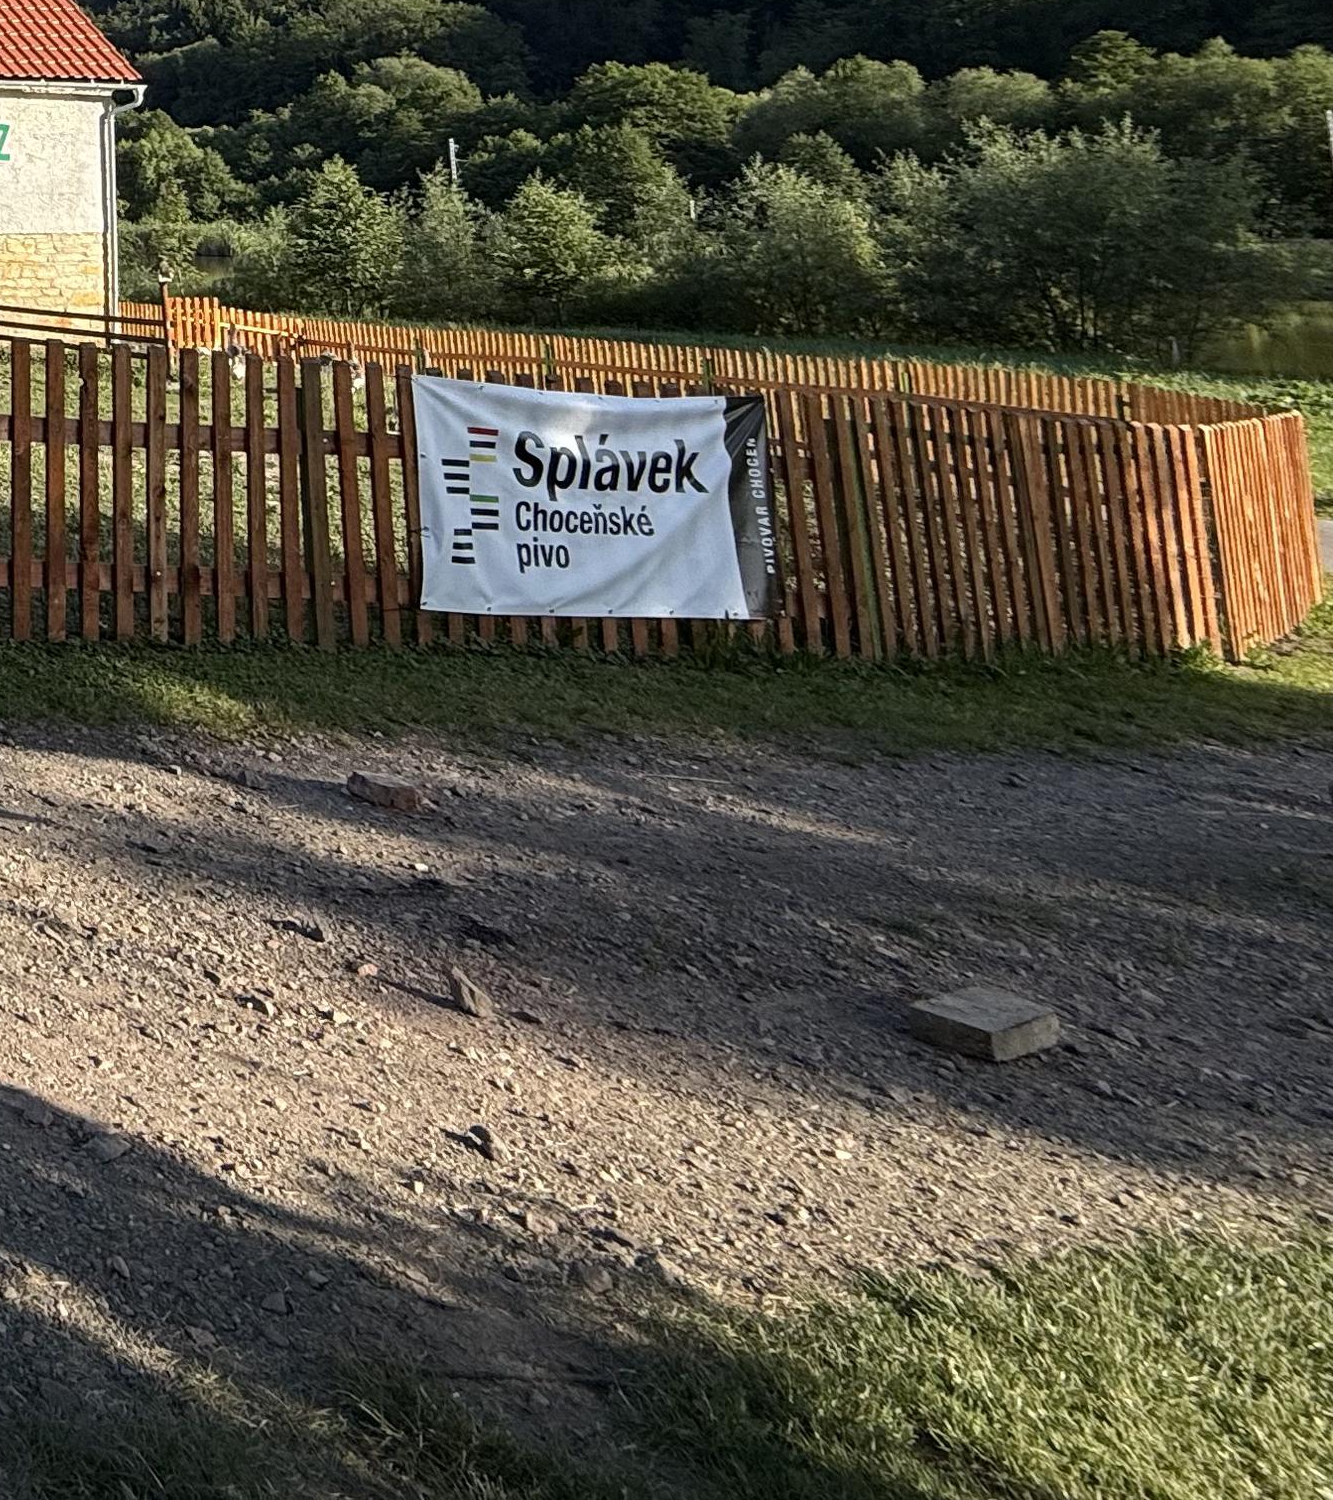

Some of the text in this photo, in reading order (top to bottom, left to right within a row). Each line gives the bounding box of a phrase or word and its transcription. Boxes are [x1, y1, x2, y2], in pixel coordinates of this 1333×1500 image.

[512, 431, 709, 501] Splávek
[515, 501, 655, 537] Choceňské
[755, 506, 776, 575] PIVOVAR
[517, 537, 570, 574] pivo
